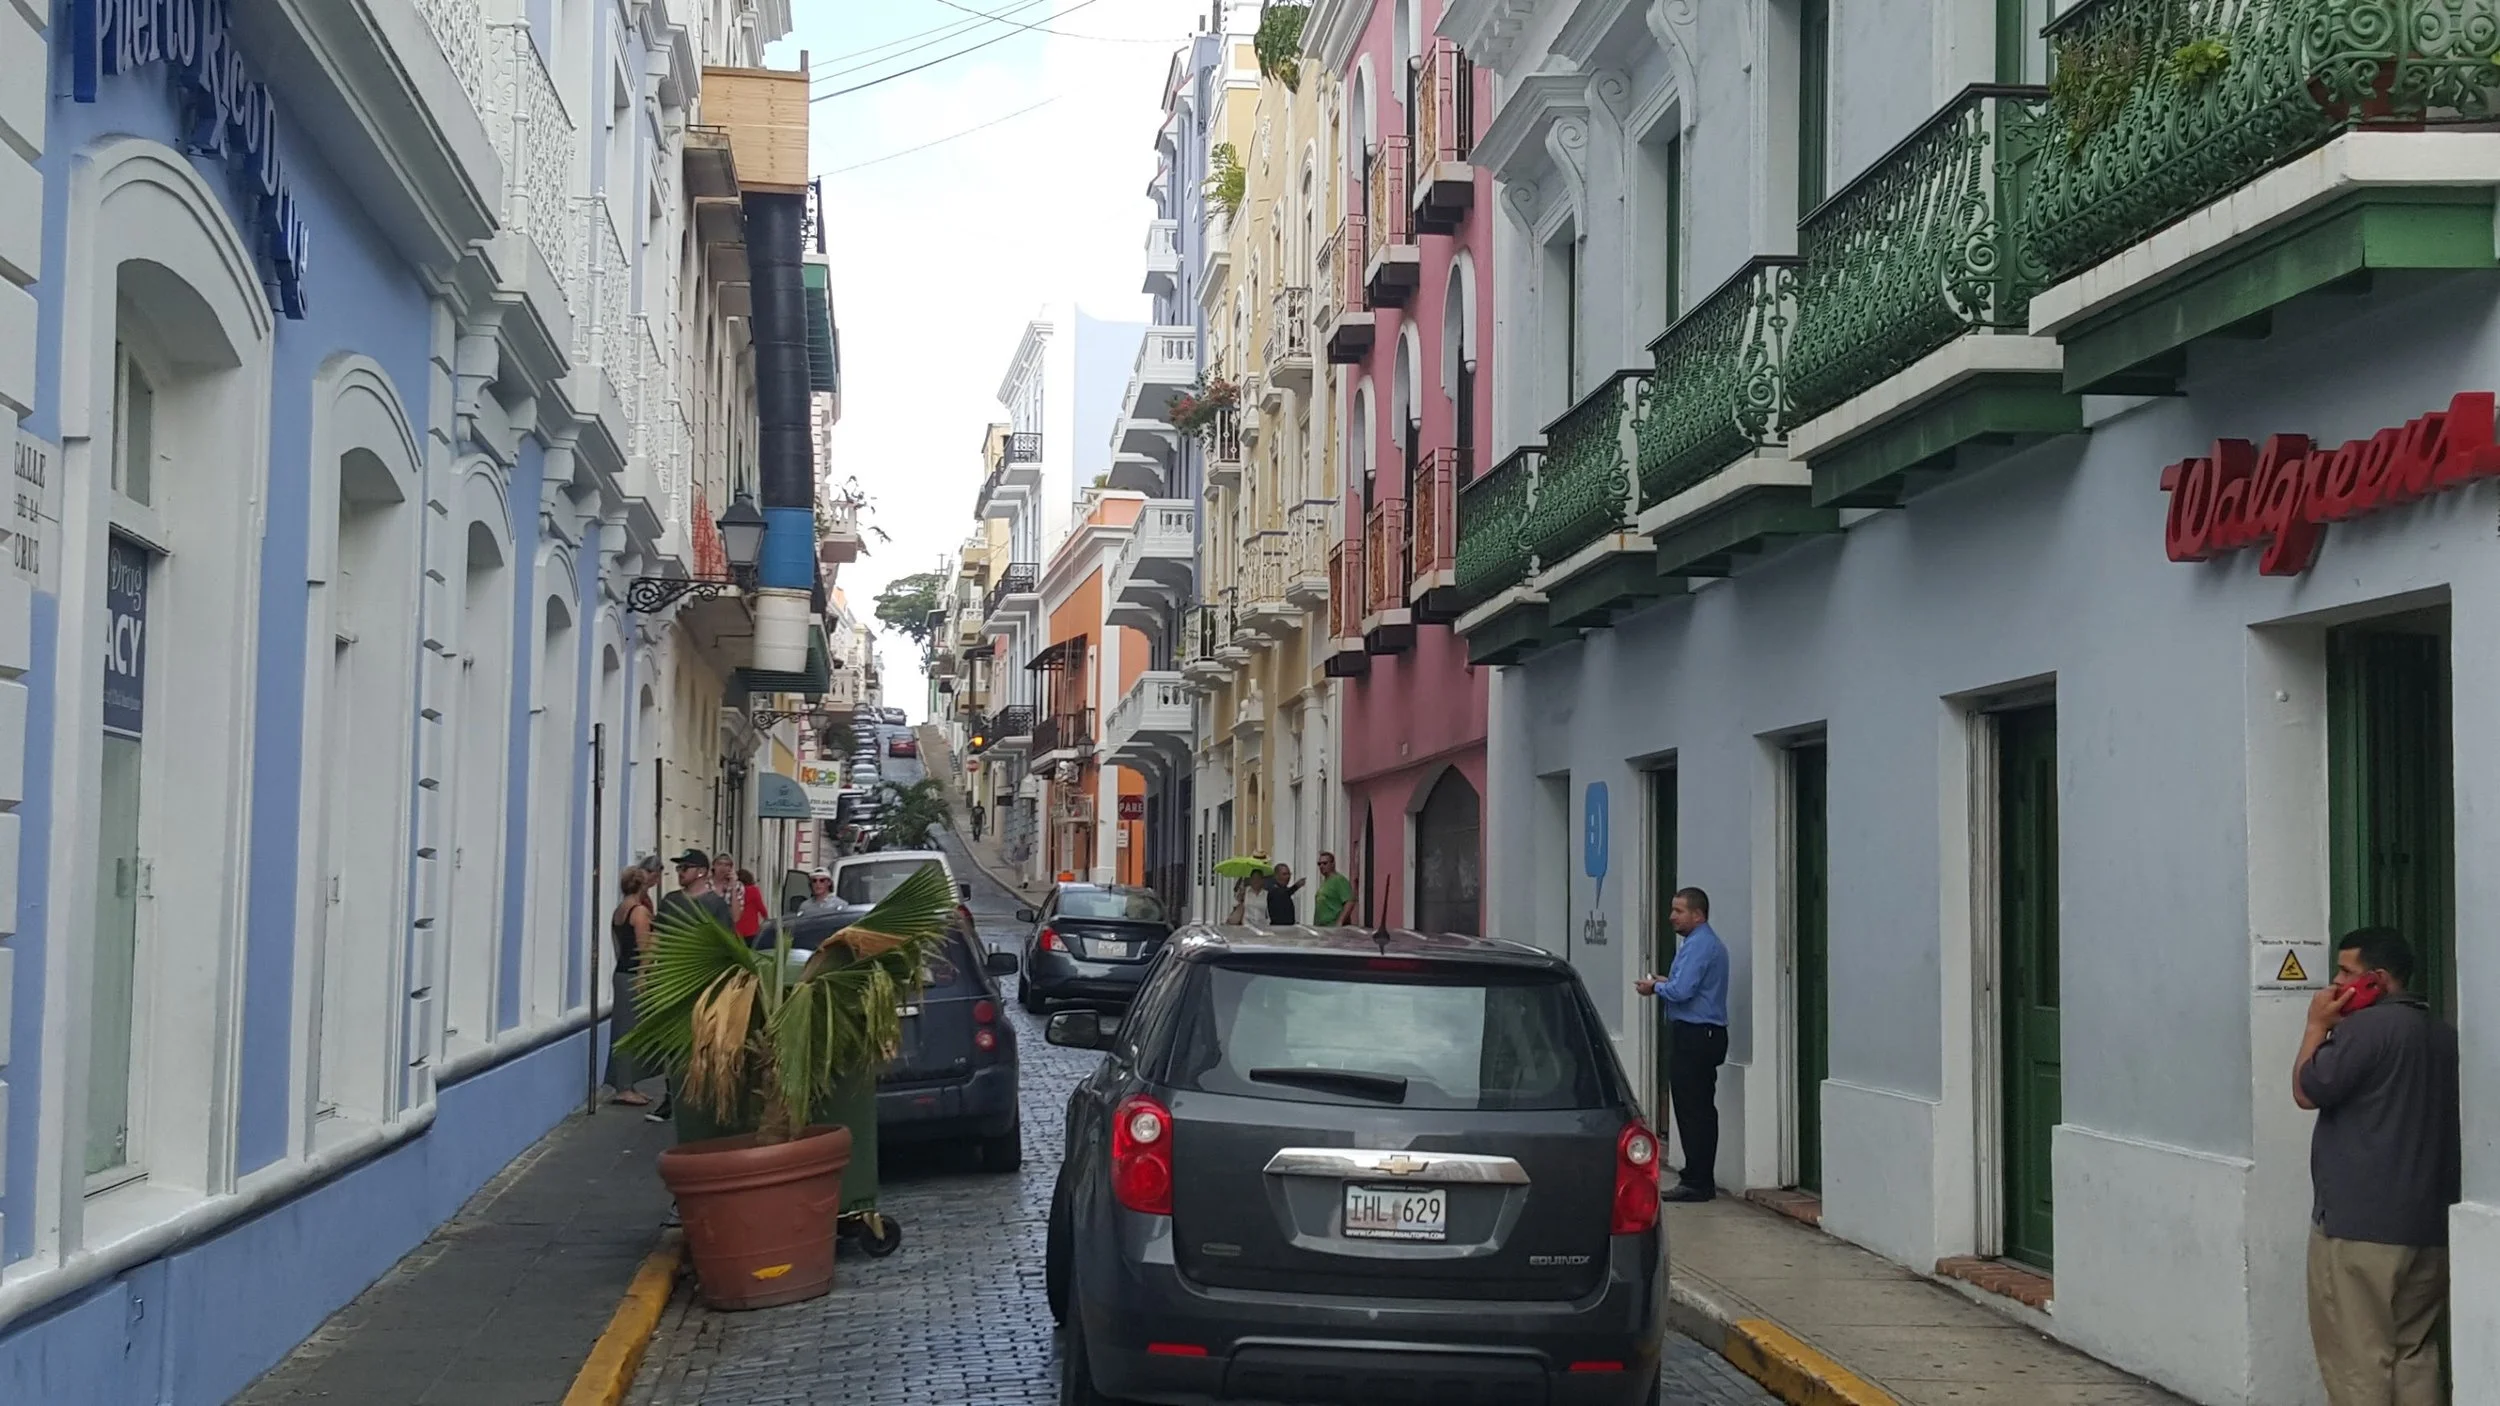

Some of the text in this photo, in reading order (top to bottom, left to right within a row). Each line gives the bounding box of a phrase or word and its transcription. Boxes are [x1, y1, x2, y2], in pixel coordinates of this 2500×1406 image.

[88, 0, 197, 80] Puerto
[14, 441, 46, 489] CALLE
[2160, 392, 2500, 576] Walgreens
[17, 493, 39, 524] DE LA
[14, 532, 39, 574] CRUZ
[109, 548, 143, 612] Drug
[1118, 802, 1144, 813] PARE
[1351, 1195, 1441, 1224] IHL 629
[1529, 1255, 1591, 1266] EQUINOX
